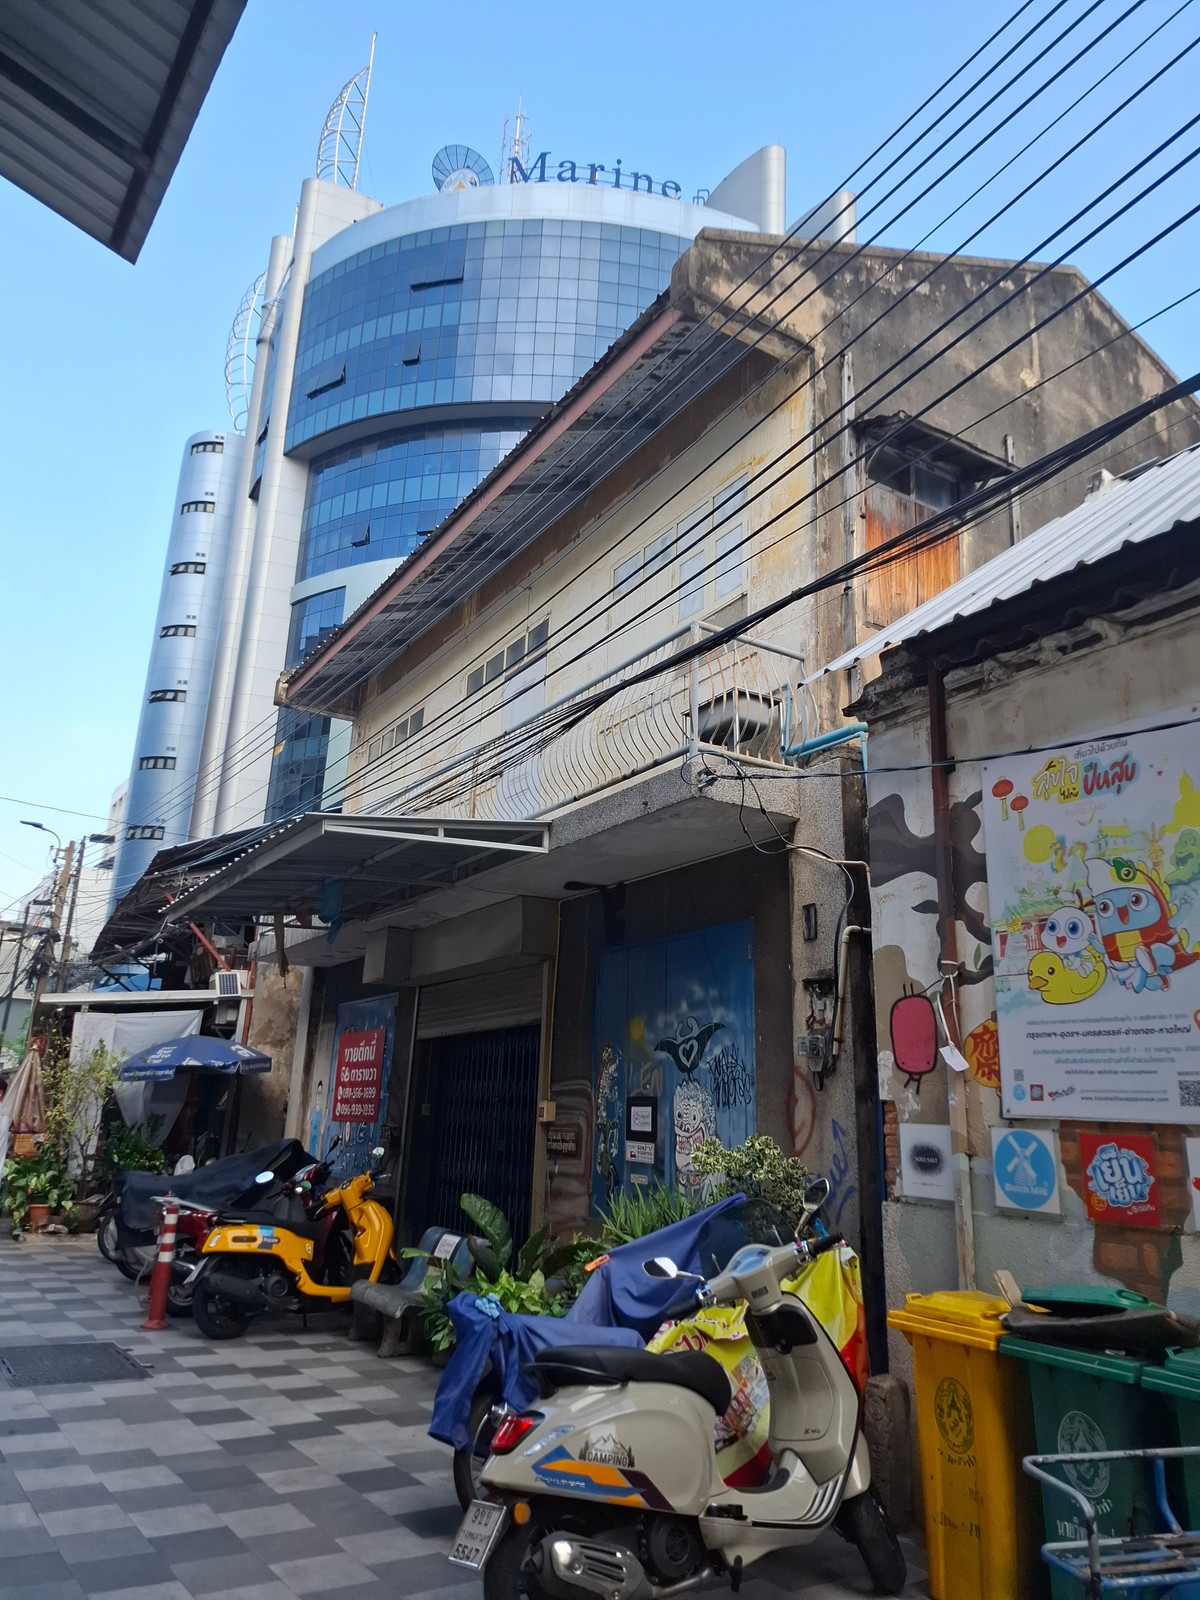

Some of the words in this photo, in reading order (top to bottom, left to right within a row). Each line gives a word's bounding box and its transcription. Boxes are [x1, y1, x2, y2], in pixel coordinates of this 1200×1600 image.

[508, 151, 682, 201] Marine
[344, 1032, 378, 1063] ขายตึกนี้
[351, 1067, 377, 1082] ตารางวา
[587, 1451, 628, 1468] CAMPING
